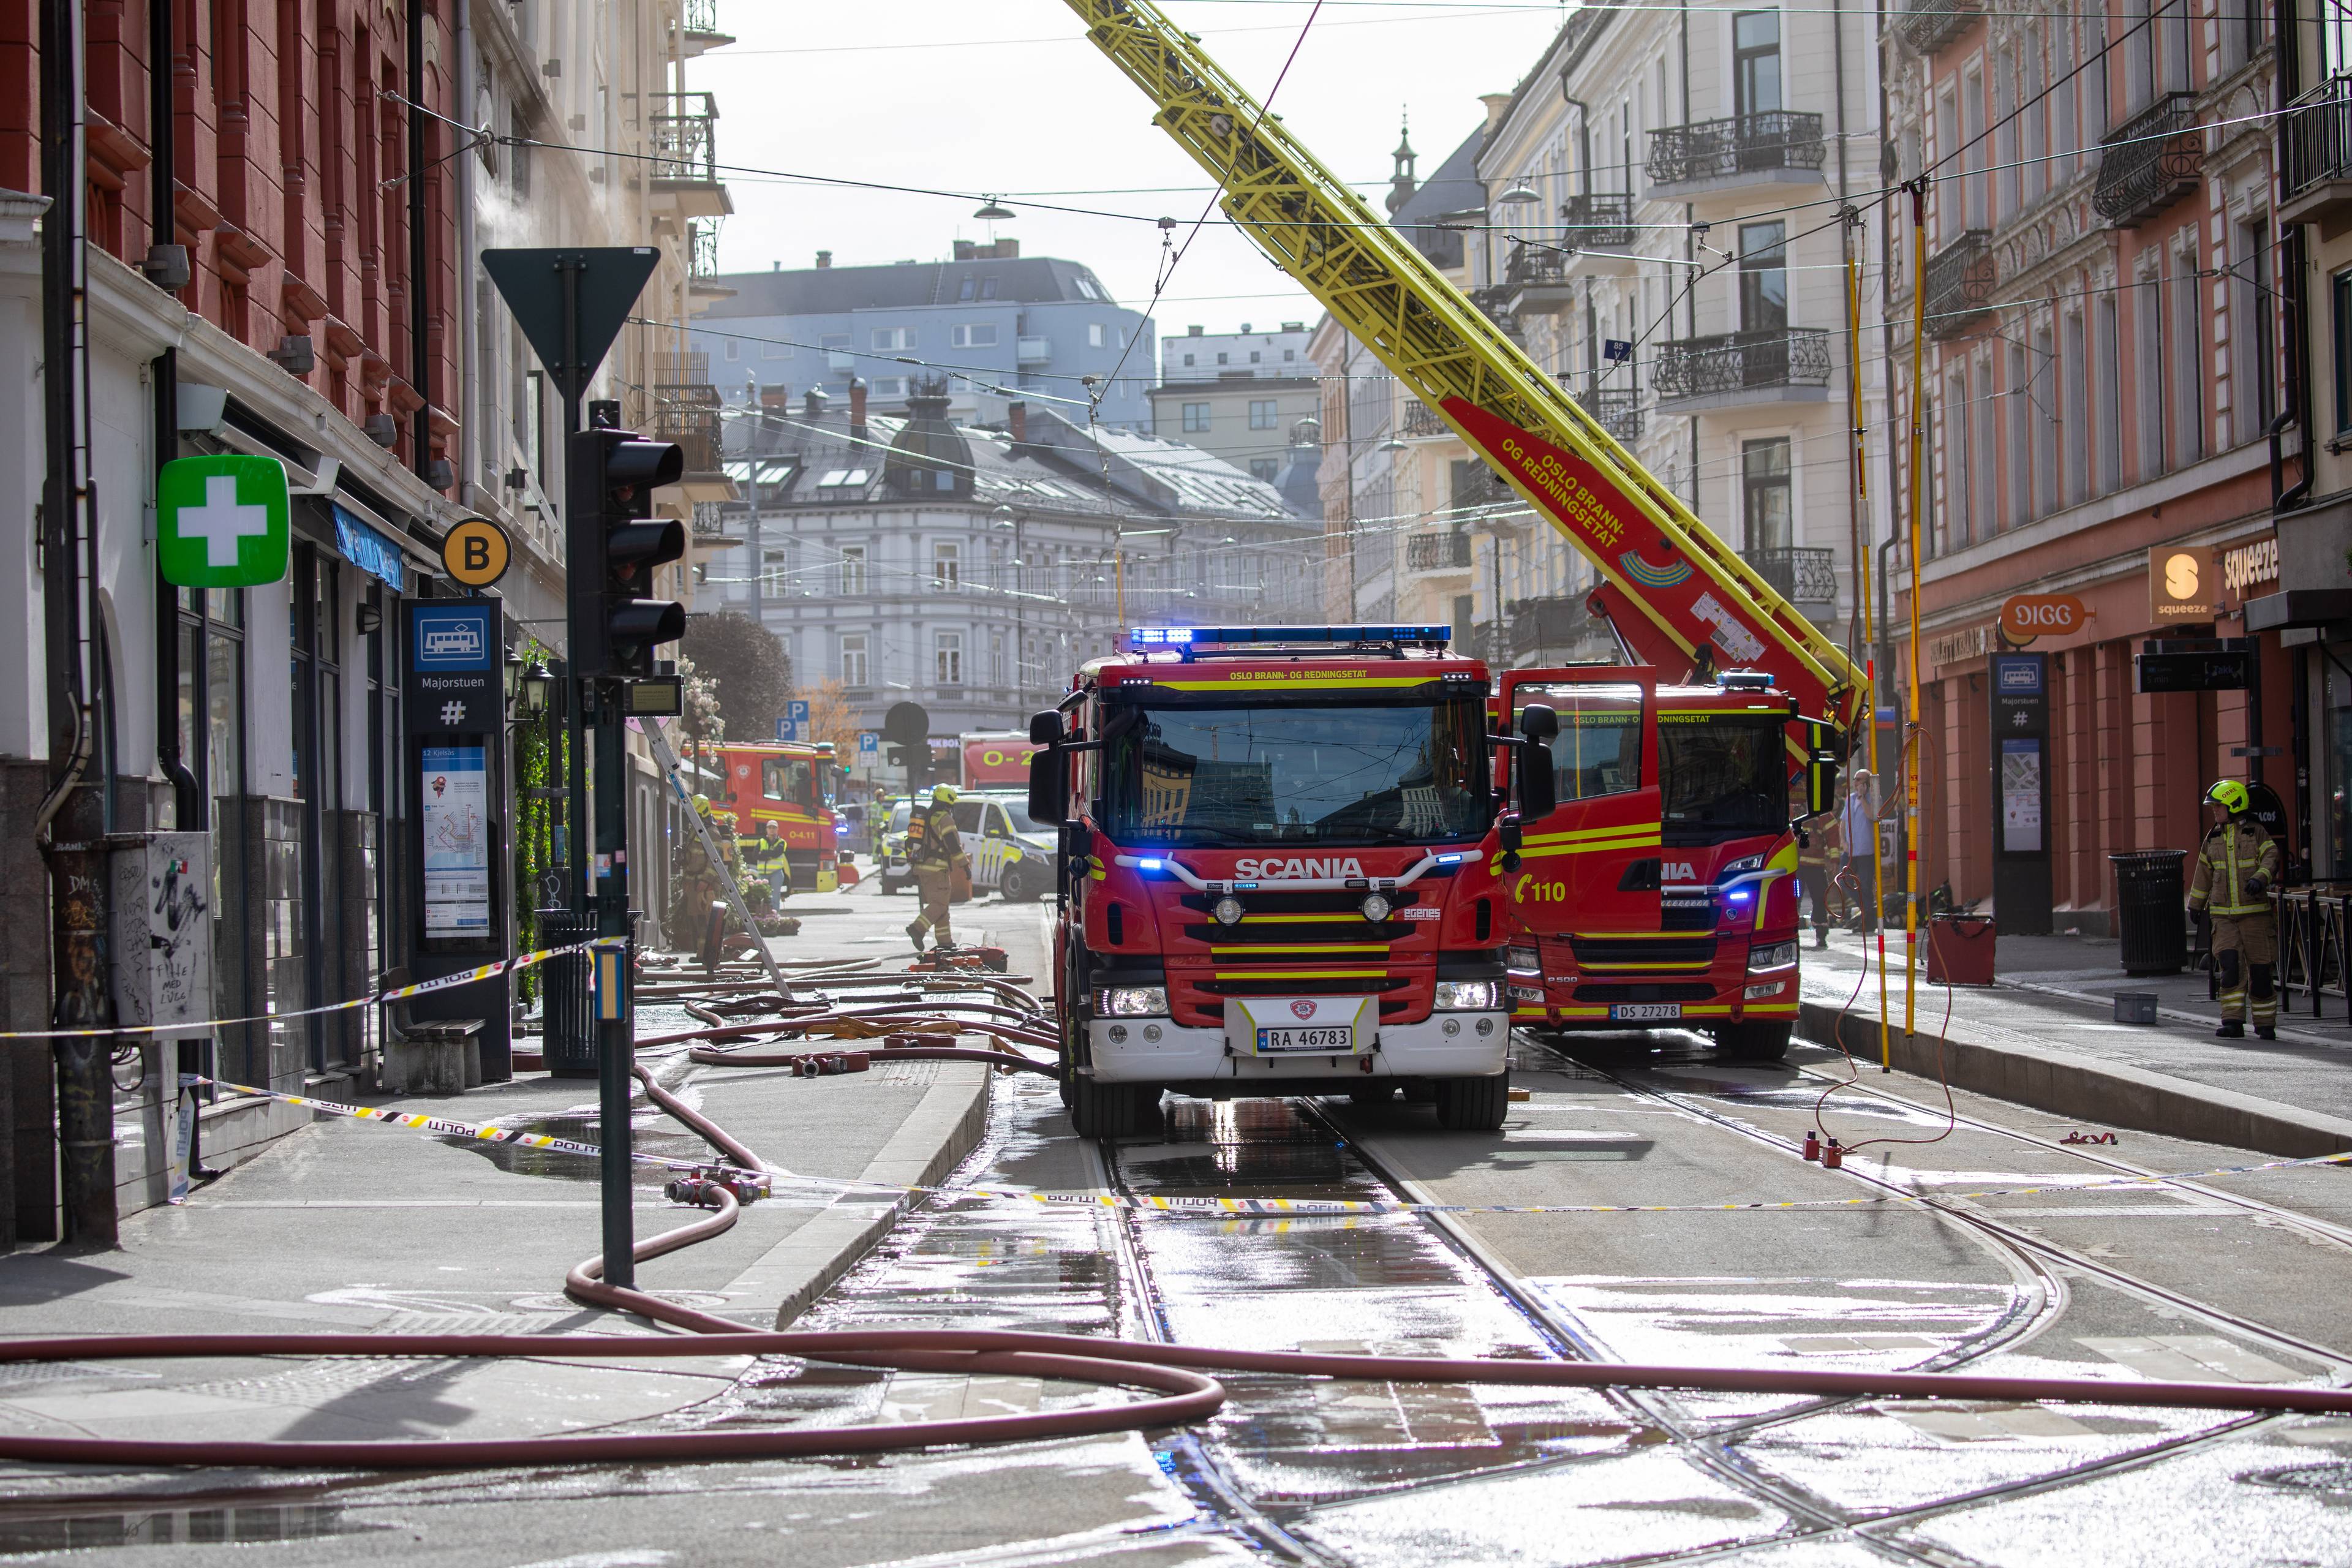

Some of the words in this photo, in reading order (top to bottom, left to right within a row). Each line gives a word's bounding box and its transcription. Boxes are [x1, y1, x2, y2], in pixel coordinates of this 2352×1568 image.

[1502, 439, 1524, 461] OG
[1521, 456, 1618, 548] REDNINGSETAT
[1542, 454, 1577, 490] OSLO
[1575, 486, 1624, 535] BRANN-
[464, 536, 490, 570] B
[2225, 538, 2278, 601] squeeze
[2015, 605, 2072, 625] DIGG
[2158, 605, 2208, 616] squeeze
[1230, 672, 1253, 680] OSLO
[1255, 671, 1287, 680] BRANN-
[1289, 671, 1302, 679] OG
[1304, 670, 1367, 679] REDNINGSETAT
[422, 677, 484, 690] Majorstuen
[2002, 698, 2038, 706] Majorstuen
[792, 703, 804, 720] P
[781, 721, 791, 739] P
[864, 736, 873, 749] P
[433, 748, 455, 757] Kjelsås
[2222, 786, 2239, 799] OBRE
[1234, 858, 1365, 880] SCANIA
[1660, 862, 1697, 880] NIA
[1531, 881, 1566, 902] 110
[420, 971, 473, 990] POLITI
[1621, 1006, 1635, 1018] DS
[1641, 1006, 1677, 1017] 27278
[1271, 1031, 1292, 1046] RA
[1298, 1030, 1347, 1046] 46783
[428, 1121, 476, 1137] POLITI
[553, 1140, 601, 1154] POLITI
